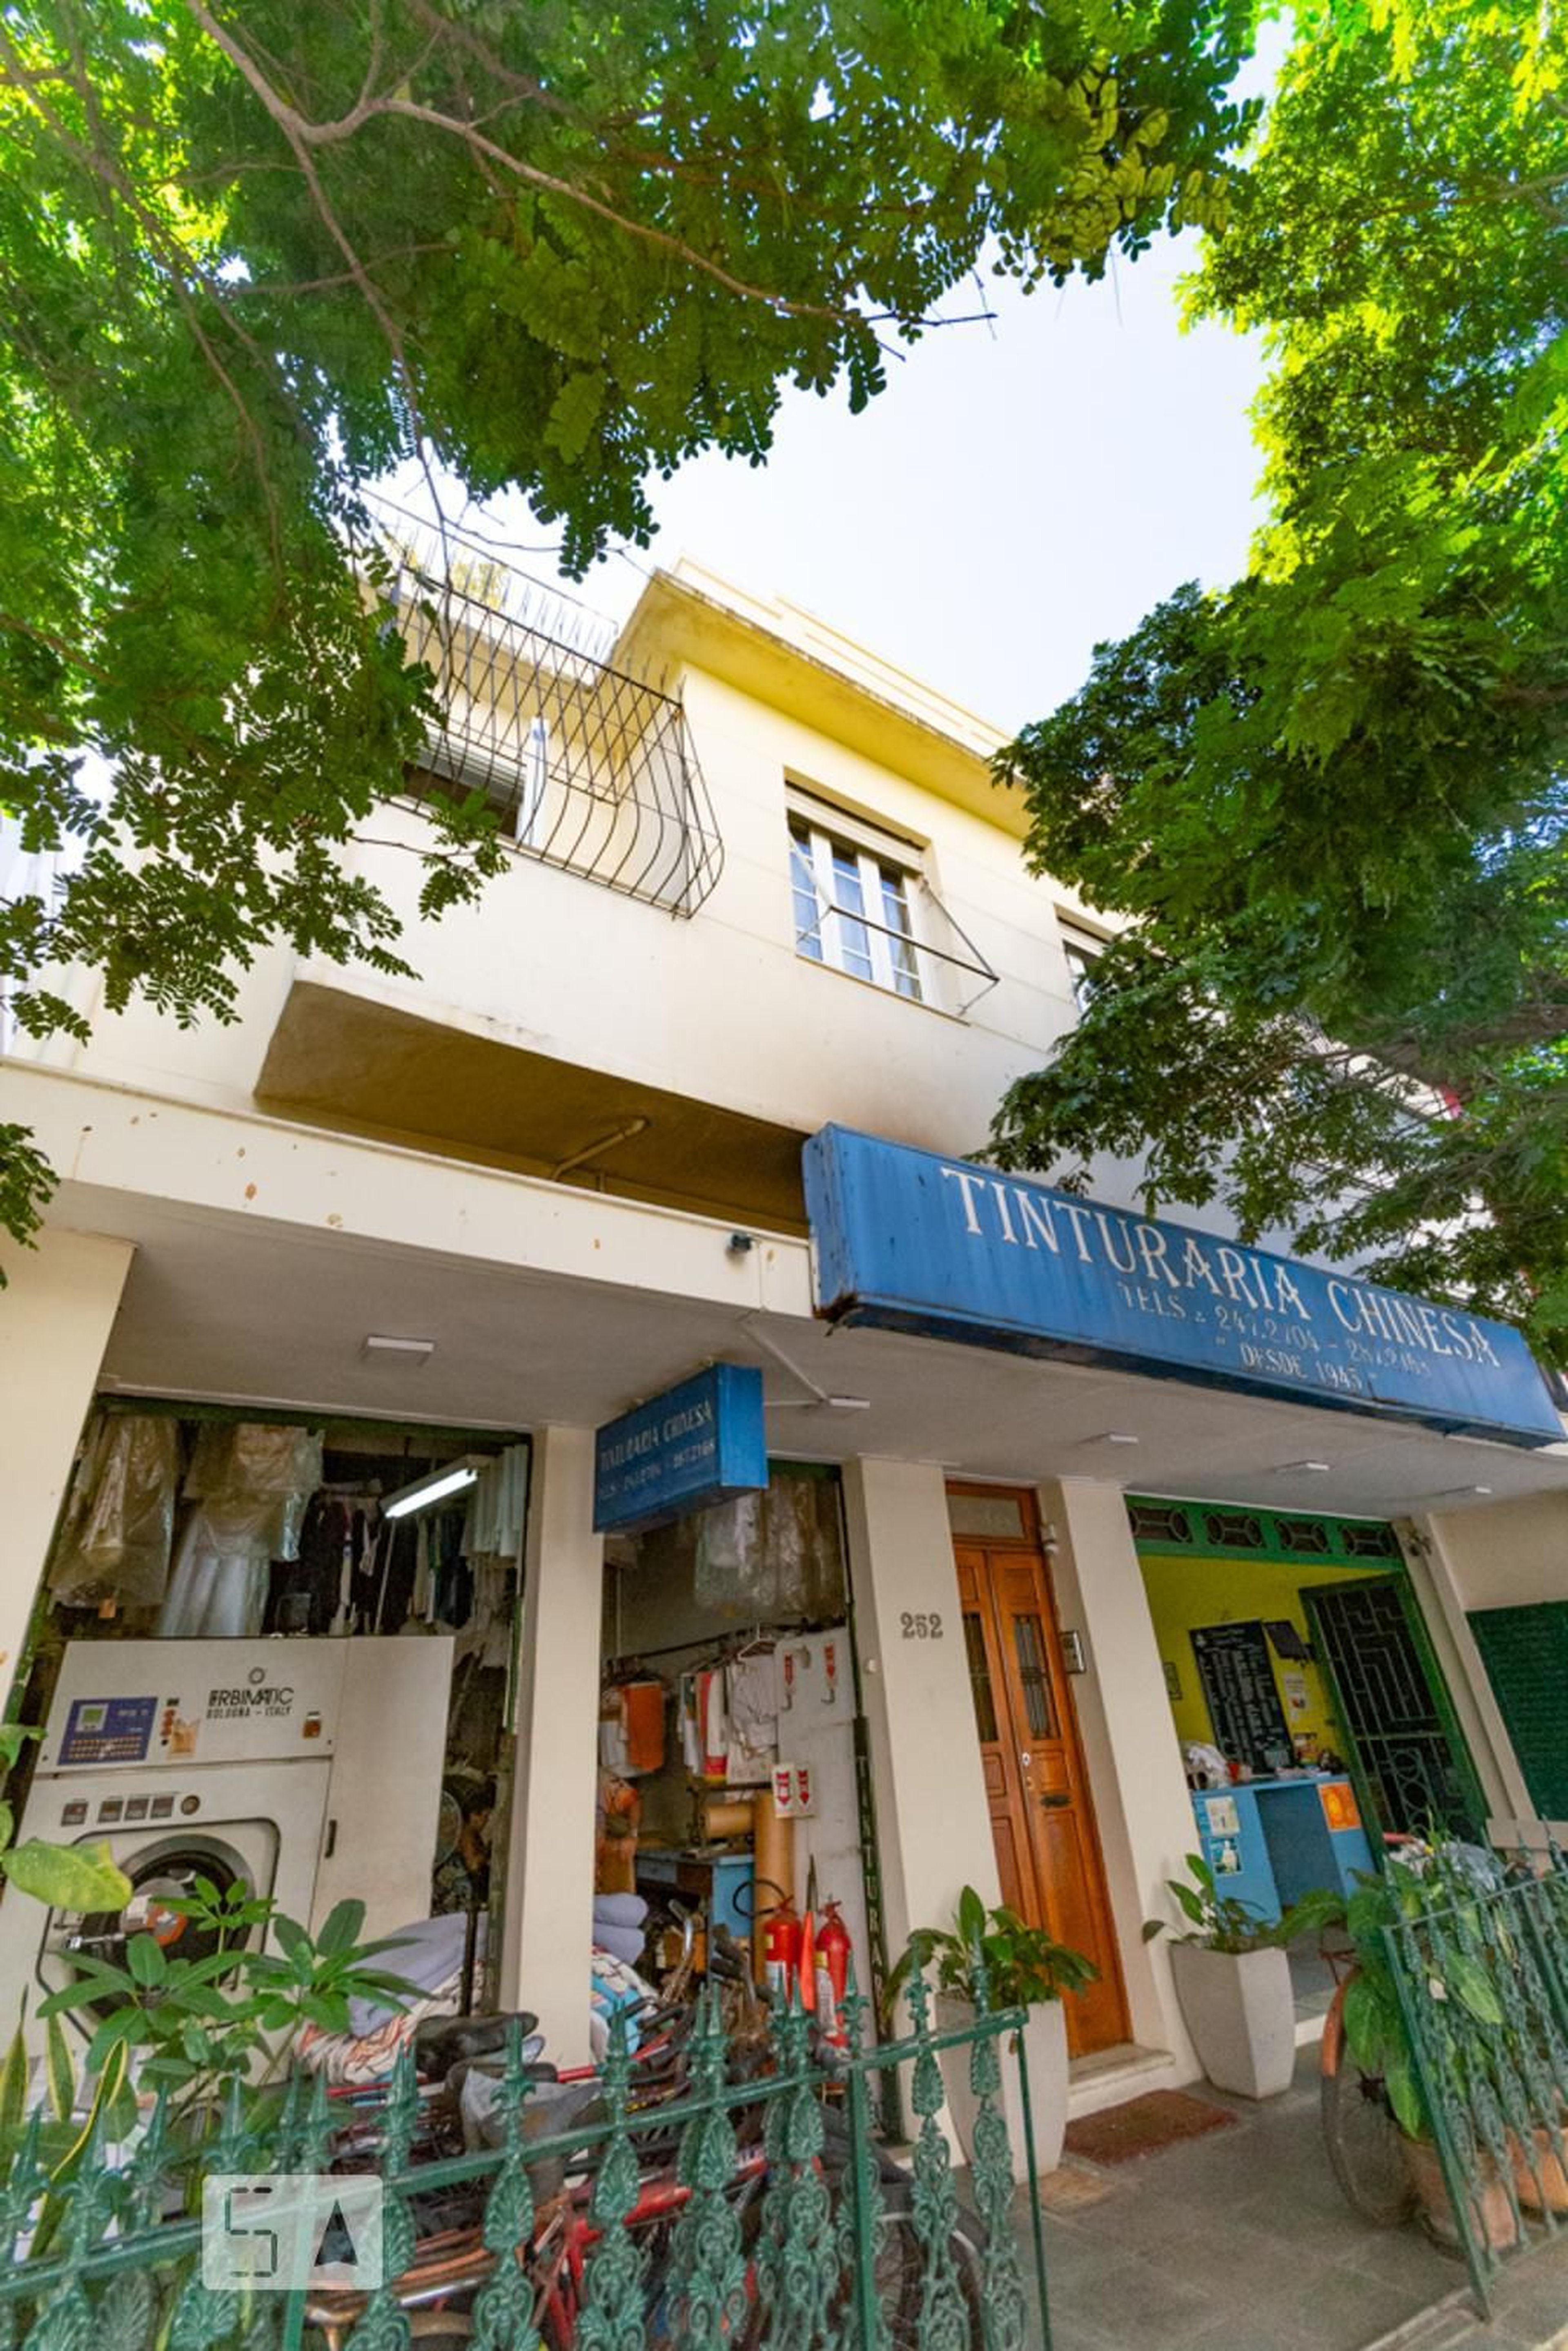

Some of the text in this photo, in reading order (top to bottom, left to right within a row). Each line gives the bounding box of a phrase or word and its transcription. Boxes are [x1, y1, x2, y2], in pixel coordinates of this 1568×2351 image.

[940, 1166, 1500, 1368] TINTURARIA CHINESA
[900, 1611, 943, 1639] 252
